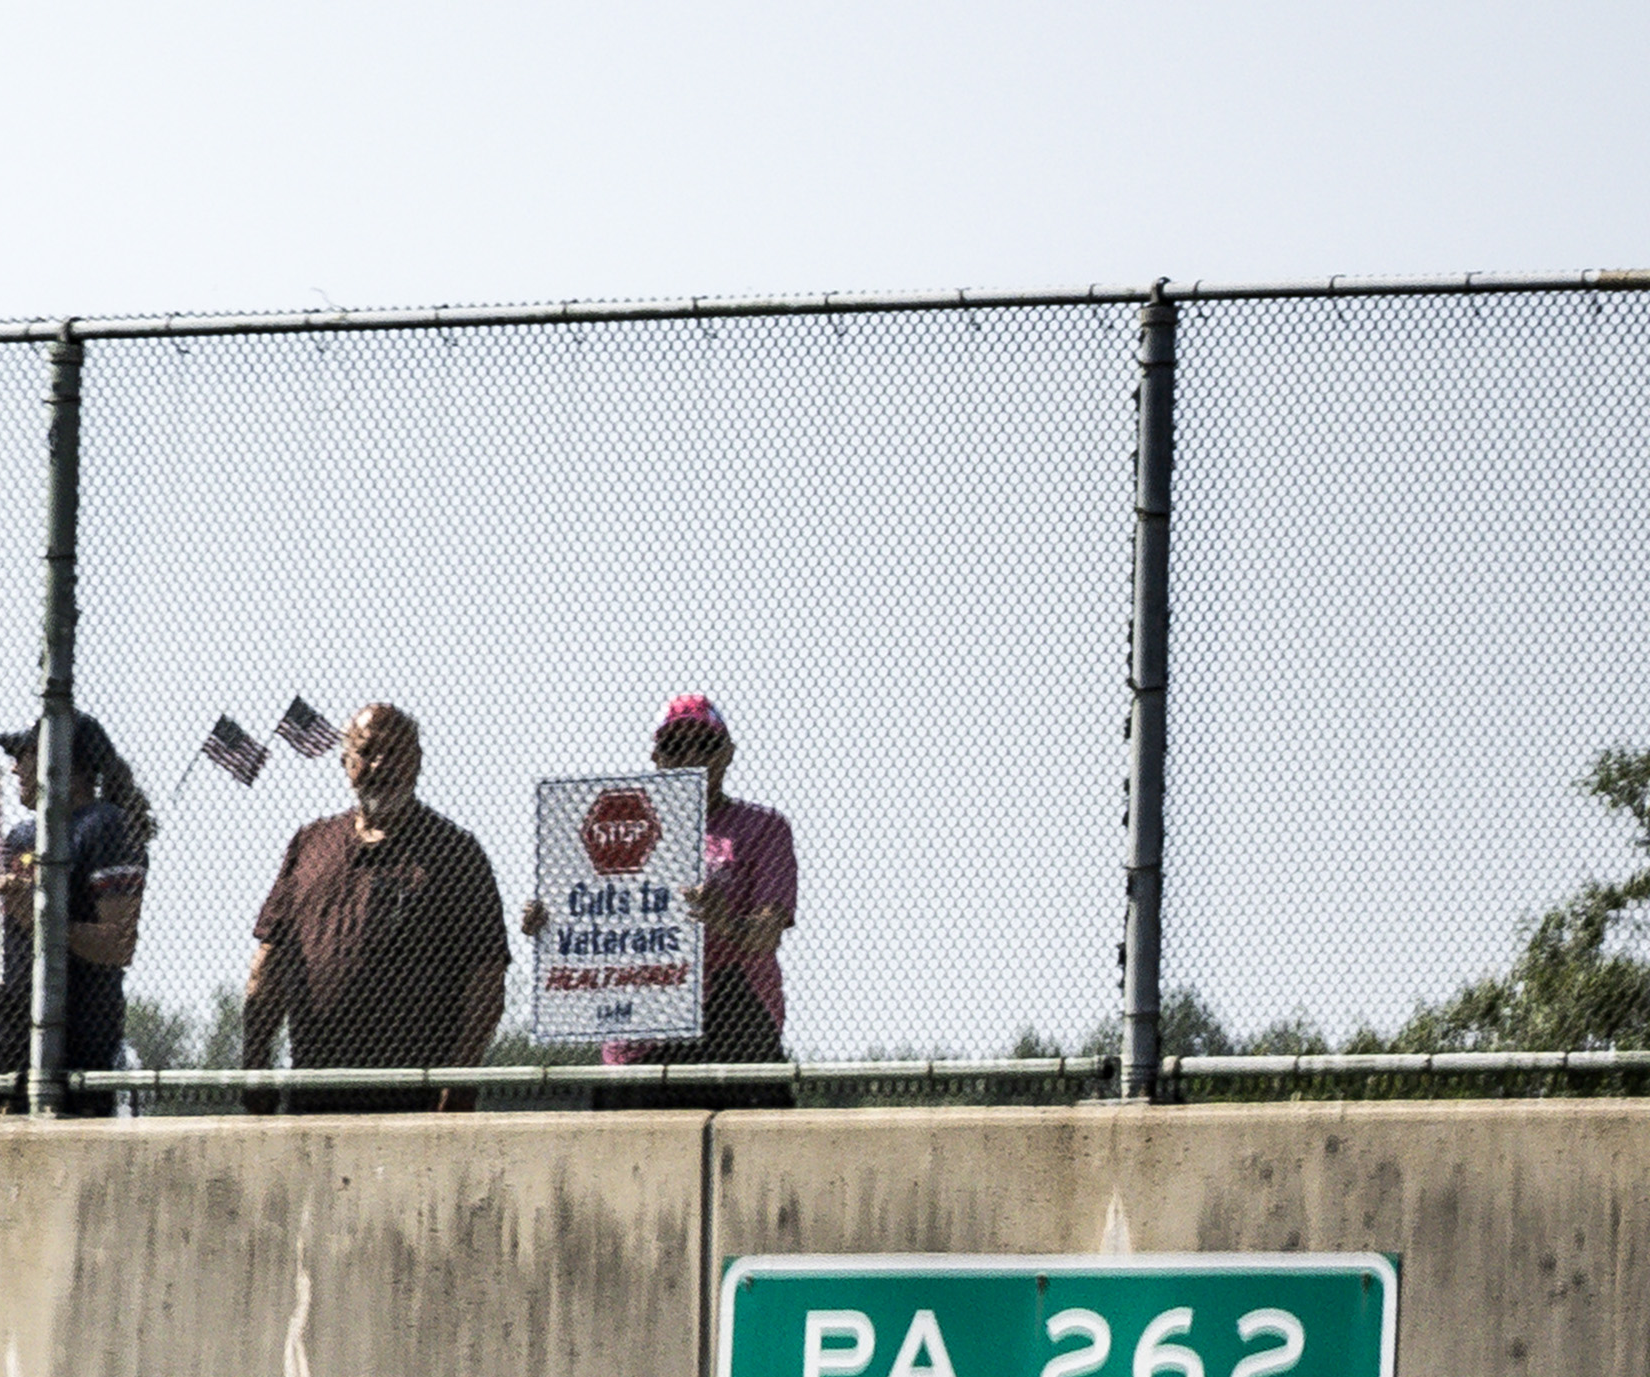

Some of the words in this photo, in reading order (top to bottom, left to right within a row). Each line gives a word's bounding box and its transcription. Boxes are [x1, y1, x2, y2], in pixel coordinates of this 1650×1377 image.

[568, 881, 631, 917] Cuts
[640, 880, 670, 914] to
[557, 922, 681, 956] Veterans
